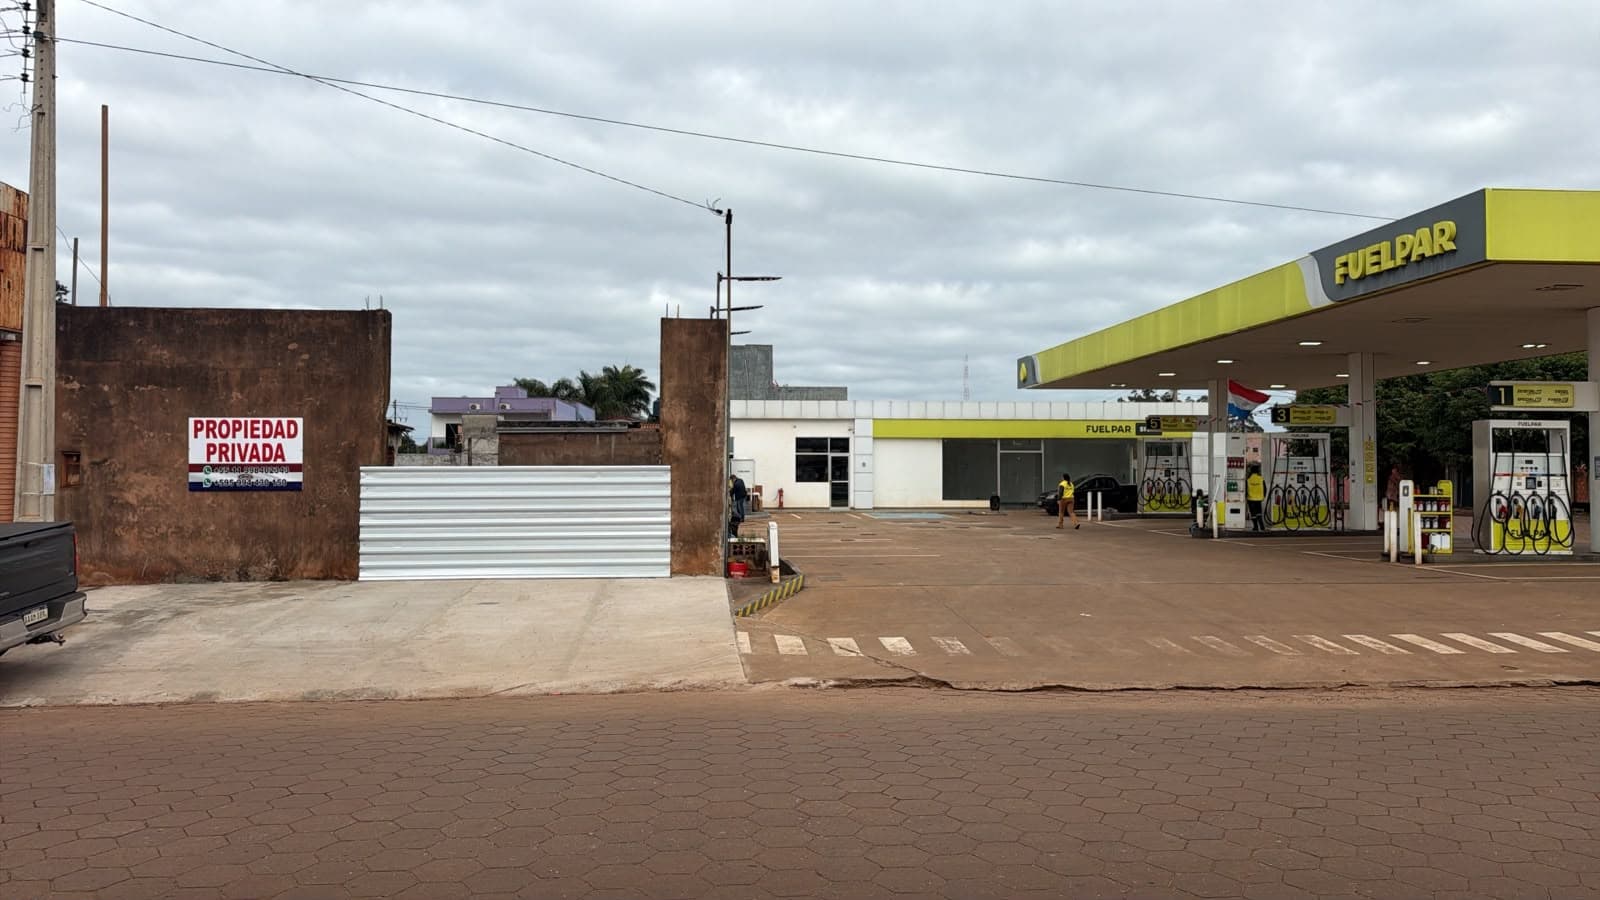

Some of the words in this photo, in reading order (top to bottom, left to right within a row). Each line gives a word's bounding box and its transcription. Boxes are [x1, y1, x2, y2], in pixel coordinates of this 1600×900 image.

[1335, 221, 1457, 285] FUELPAR
[1499, 387, 1505, 405] 1
[1150, 418, 1159, 429] 5
[1277, 409, 1286, 422] 3
[193, 419, 299, 439] PROPIEDAD
[1086, 424, 1132, 433] FUELPAR
[206, 443, 286, 462] PRIVADA
